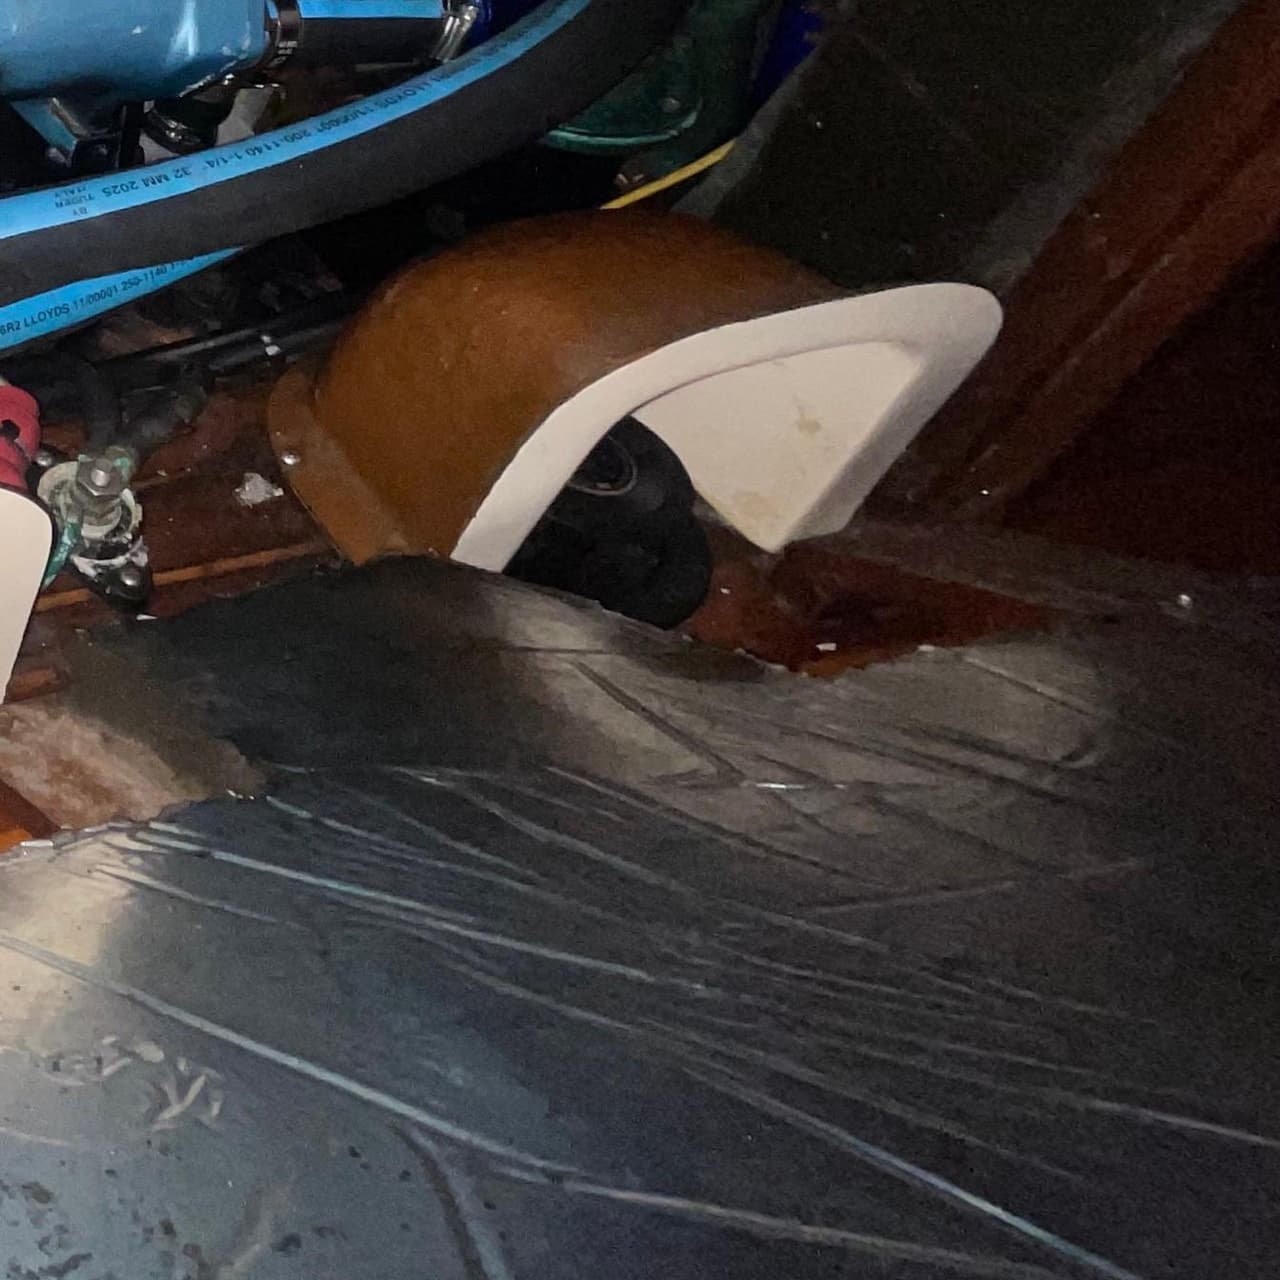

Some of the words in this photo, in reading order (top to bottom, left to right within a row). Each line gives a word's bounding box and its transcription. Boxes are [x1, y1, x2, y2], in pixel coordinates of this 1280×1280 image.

[142, 173, 171, 189] MM
[173, 167, 193, 180] 32
[101, 180, 139, 198] 2025
[23, 303, 71, 328] LLOYDS
[73, 285, 119, 312] 11/00001
